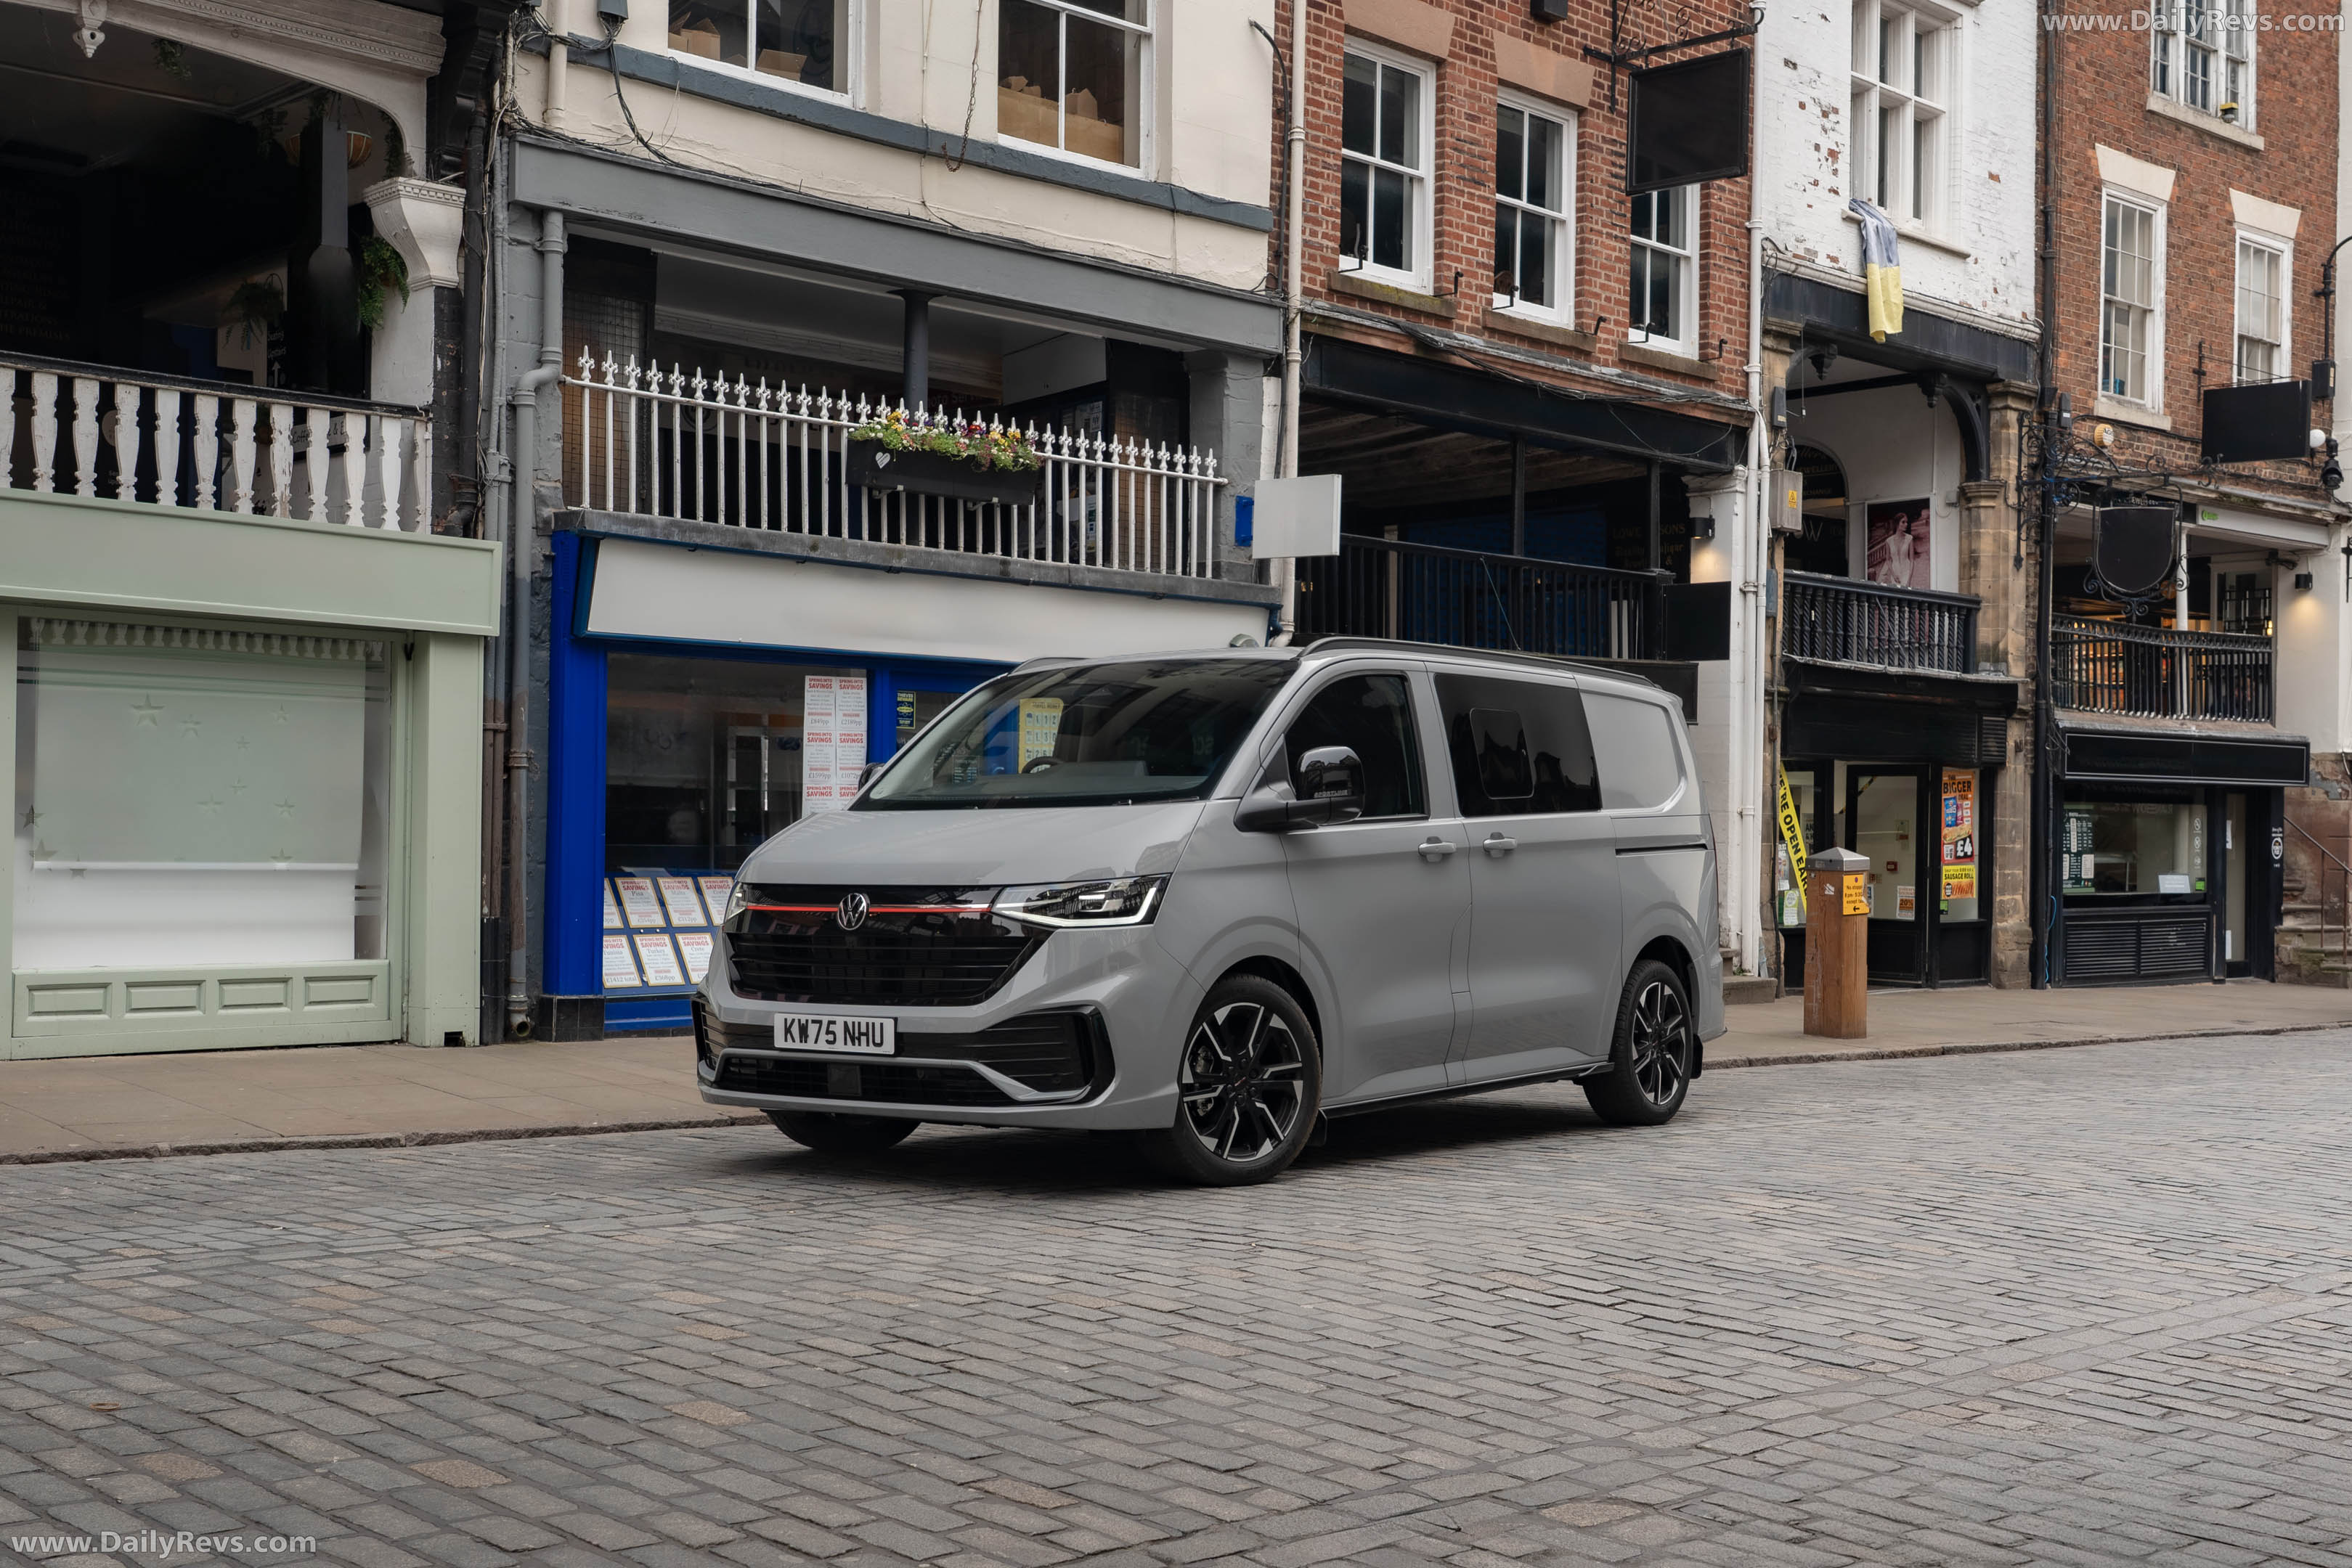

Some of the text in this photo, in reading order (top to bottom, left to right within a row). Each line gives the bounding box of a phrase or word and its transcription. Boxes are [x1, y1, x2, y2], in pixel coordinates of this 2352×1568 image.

[1943, 781, 1971, 794] BIGGER
[1783, 814, 1801, 856] OPEN
[1956, 837, 1972, 857] £4
[784, 1018, 884, 1048] KW75 NHU
